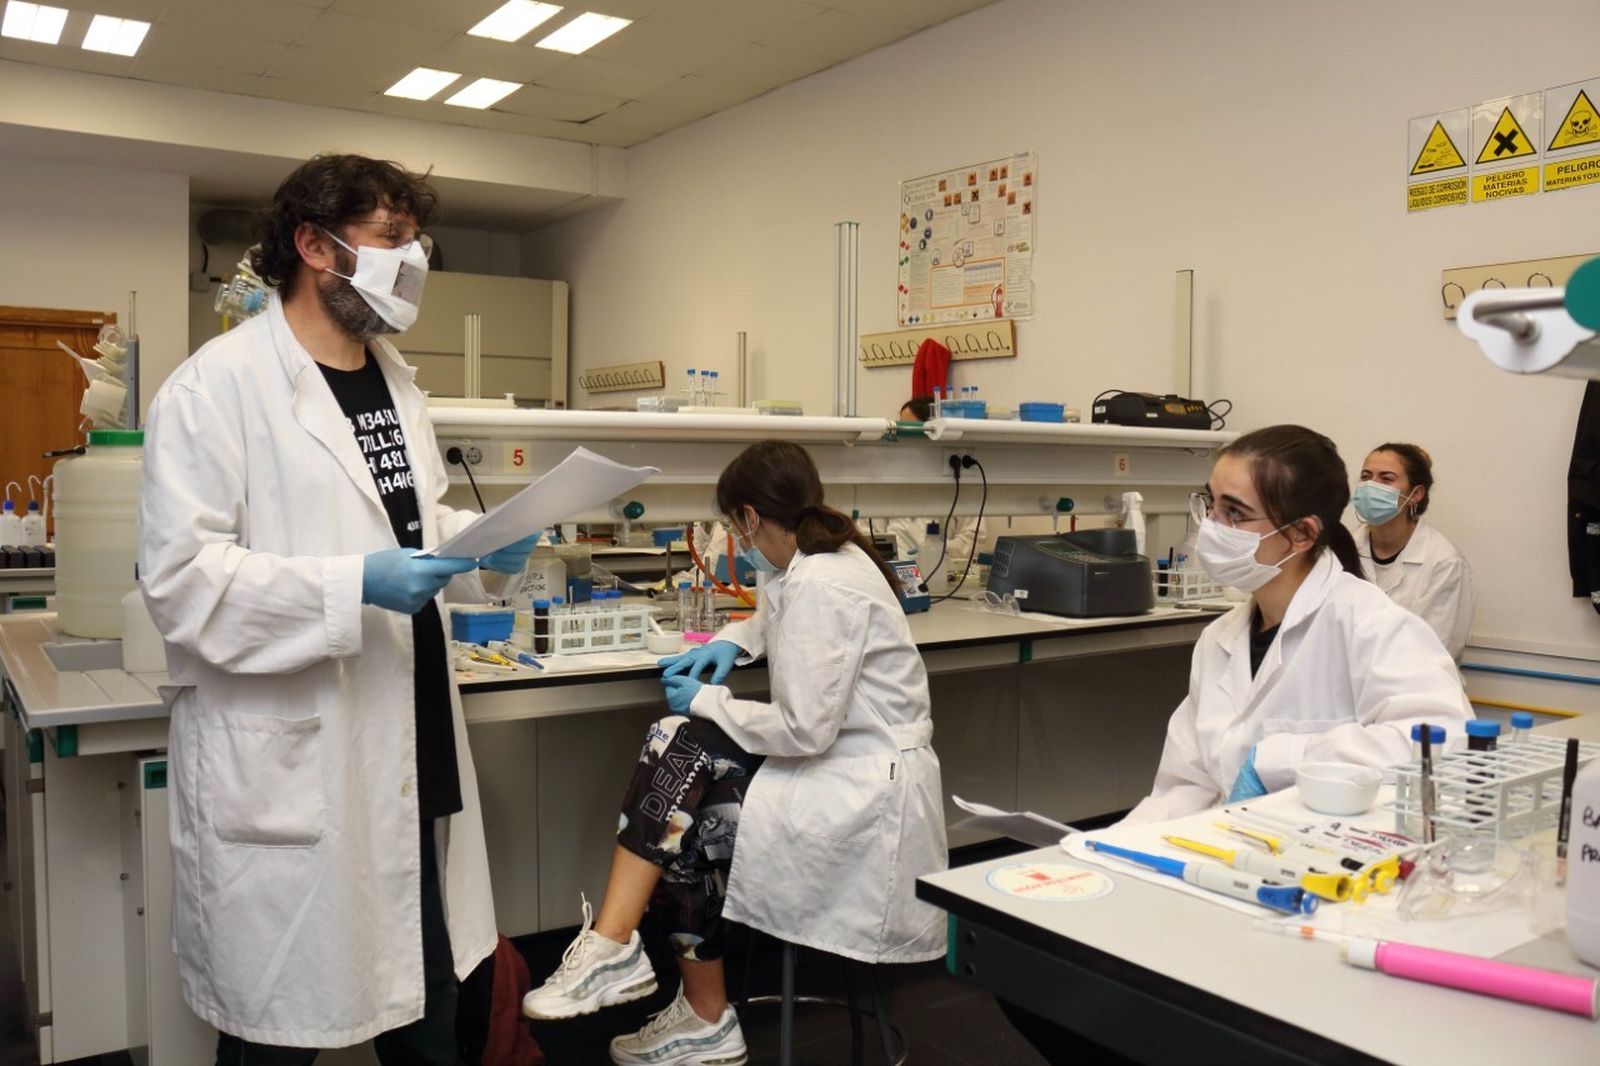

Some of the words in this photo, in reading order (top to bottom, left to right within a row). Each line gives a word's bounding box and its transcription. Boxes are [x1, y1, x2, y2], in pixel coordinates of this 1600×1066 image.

[1486, 171, 1525, 183] PELIGRO
[1546, 175, 1582, 186] MATERIAS
[1484, 178, 1528, 191] MATERIAS
[1486, 187, 1525, 198] NOCIVAS
[513, 448, 524, 466] 5
[1119, 457, 1126, 471] 6
